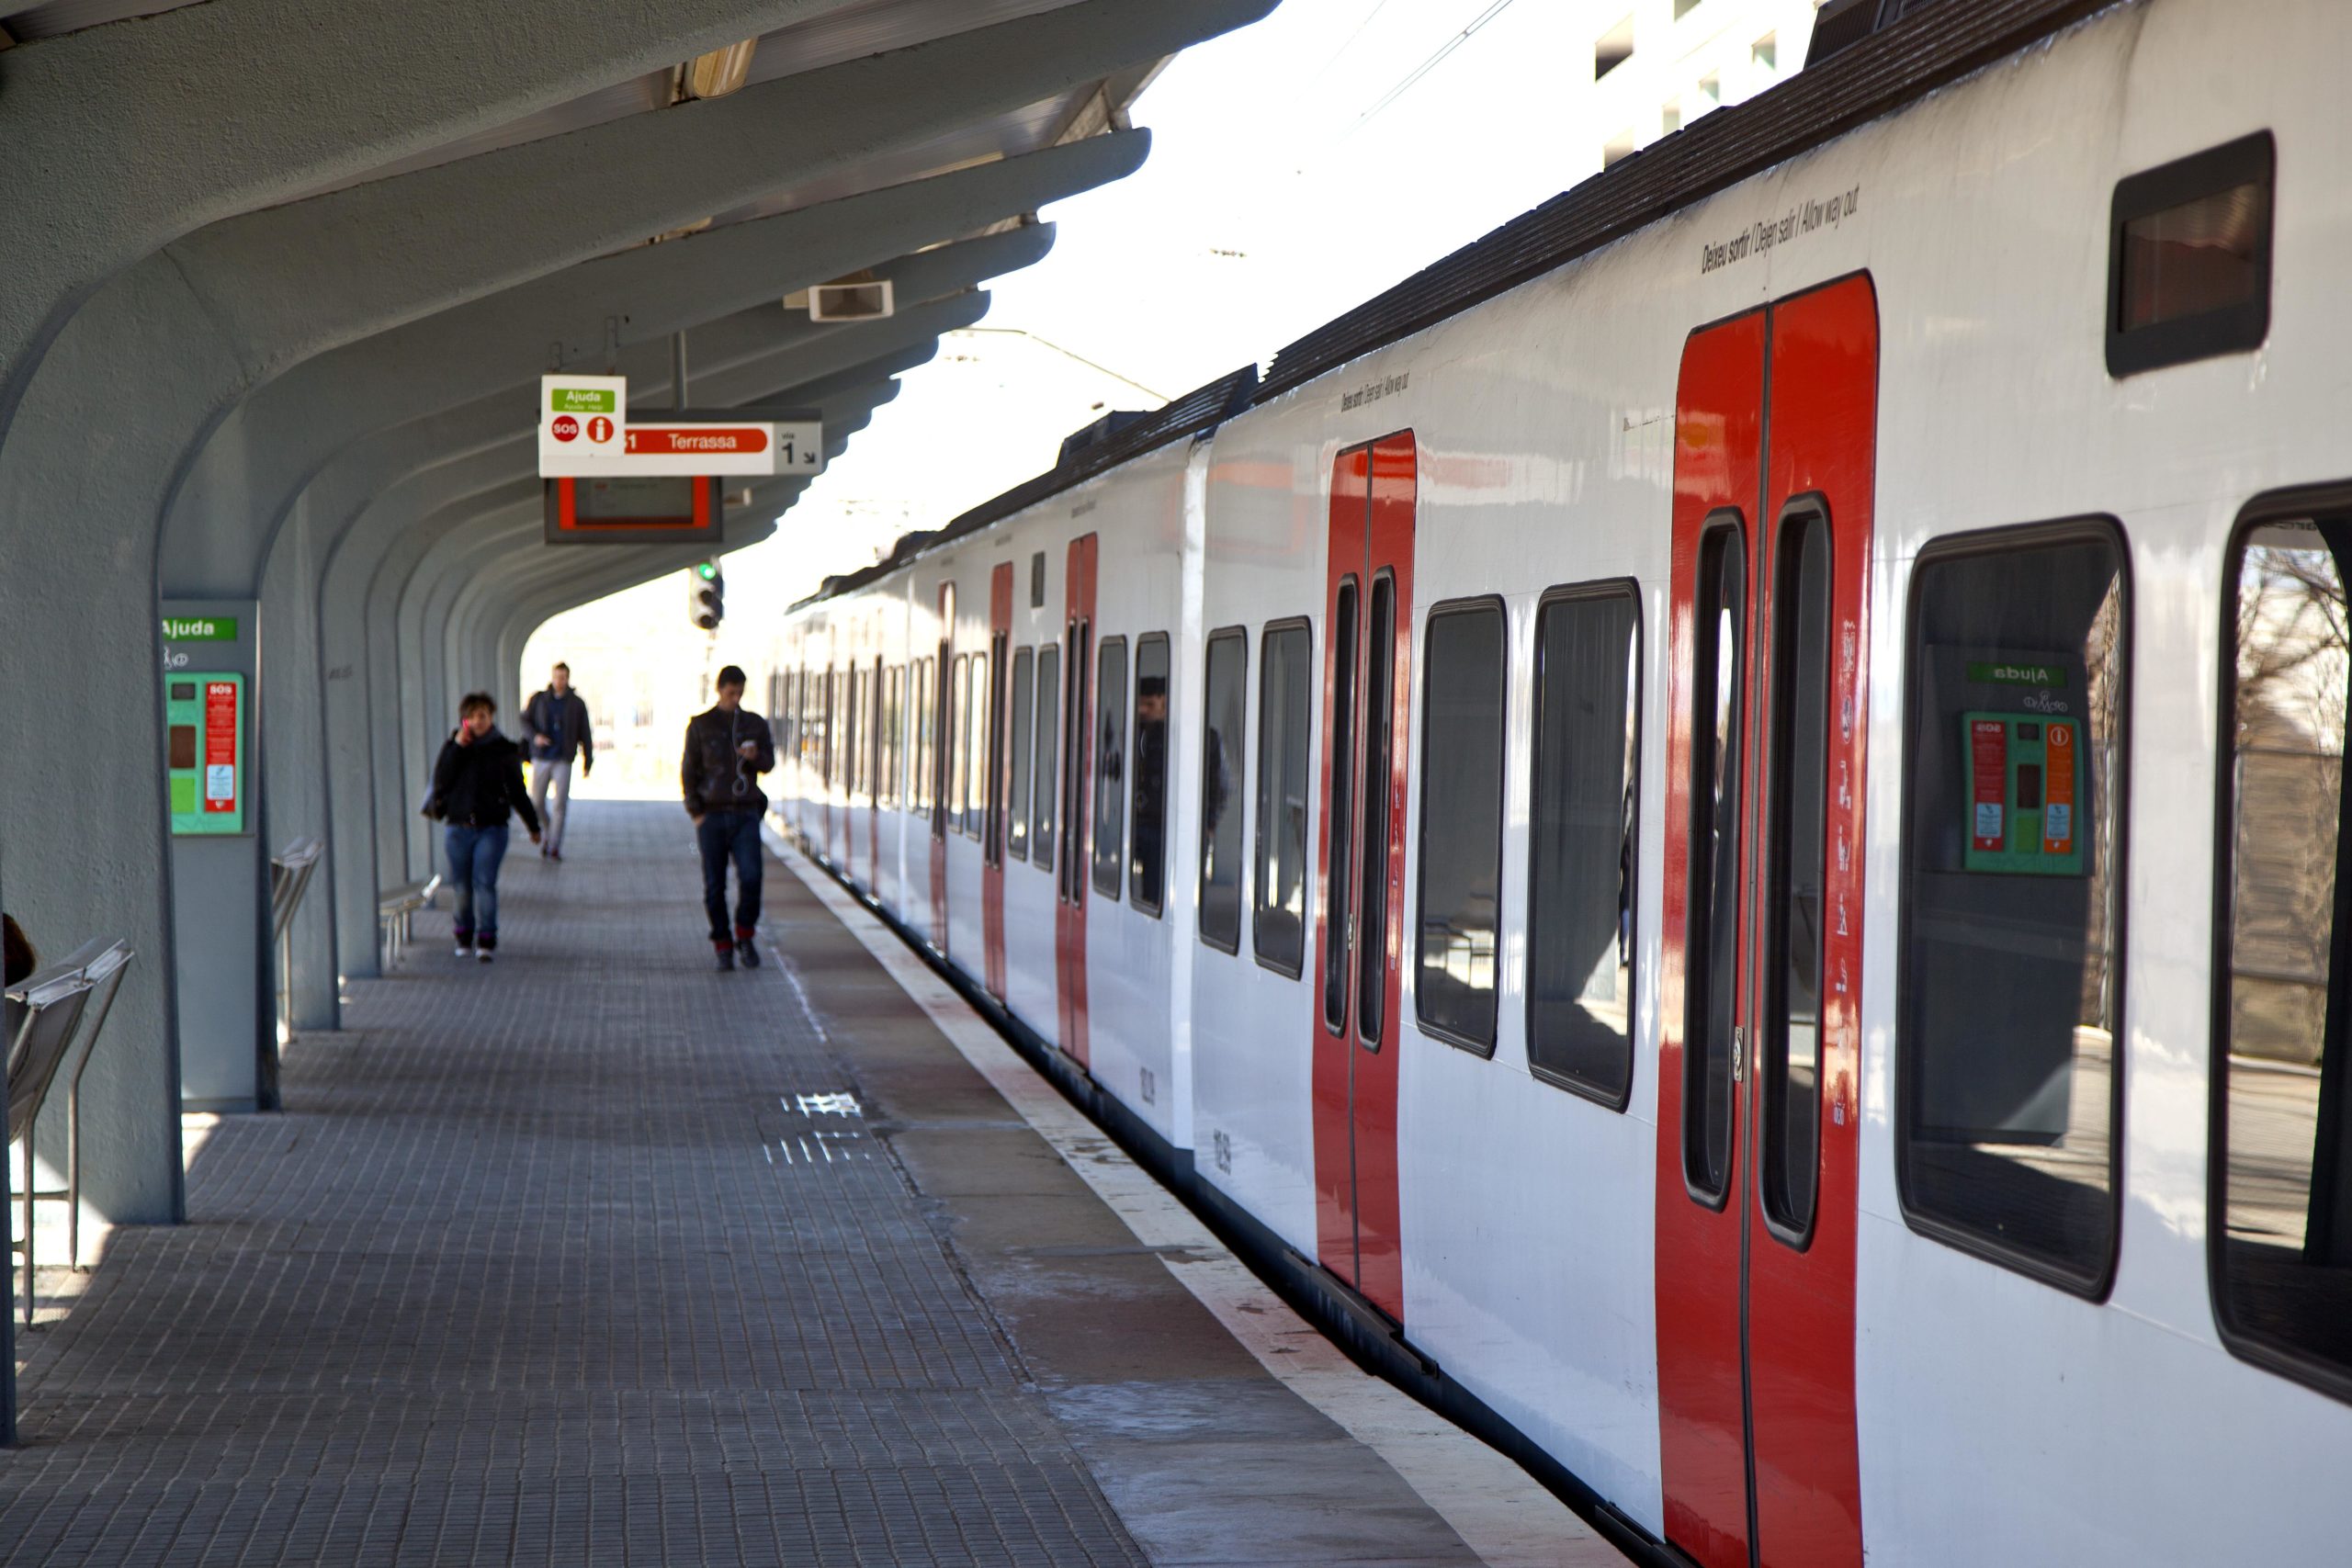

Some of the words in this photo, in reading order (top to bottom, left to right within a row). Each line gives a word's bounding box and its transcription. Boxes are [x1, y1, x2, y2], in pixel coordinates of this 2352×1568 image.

[1702, 241, 1728, 275] Deixeu
[1728, 227, 1750, 264] sortir
[1755, 220, 1778, 257] Dejen
[1778, 208, 1796, 244] salir
[1801, 198, 1826, 235] Allow
[1825, 194, 1845, 230] way
[1844, 184, 1860, 218] out
[566, 390, 602, 403] Ajuda
[553, 423, 578, 434] SOS
[667, 433, 737, 449] Terrassa
[782, 442, 794, 465] 1
[209, 683, 232, 695] SOS
